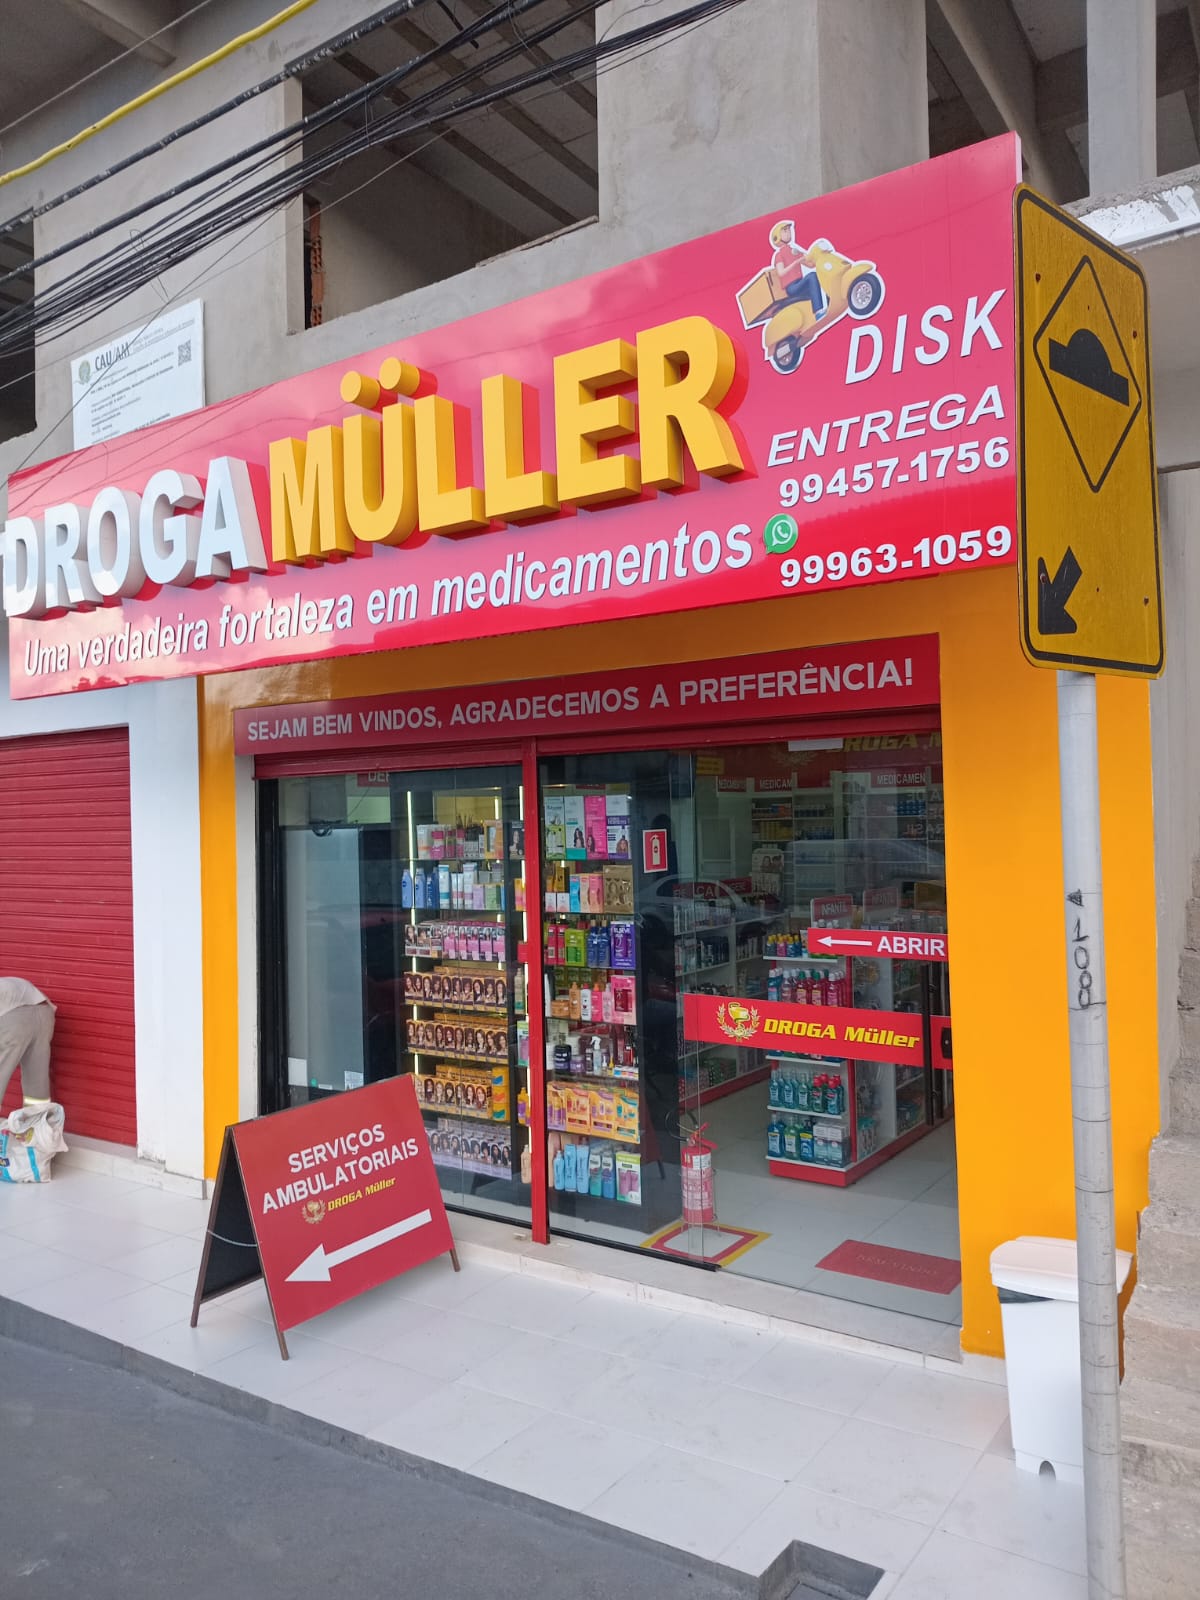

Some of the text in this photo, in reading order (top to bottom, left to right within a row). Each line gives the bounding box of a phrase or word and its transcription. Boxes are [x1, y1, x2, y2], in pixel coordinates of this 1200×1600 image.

[845, 289, 1007, 385] DISK
[767, 385, 1006, 467] ENTREGA
[3, 316, 744, 617] DROGA MÜLLER
[779, 436, 1010, 508] 99457-1756
[780, 525, 1012, 587] 99963-1059
[24, 521, 753, 677] Uma verdadeira fortaleza em medicamentos
[247, 657, 913, 741] SEJAM BEM VINDOS, AGRADECEMOS A PREFERÊNCIA!
[876, 934, 946, 957] ABRIR
[763, 1018, 920, 1048] DROGA Müller
[263, 1138, 419, 1214] AMBULATORIAIS
[288, 1123, 385, 1173] SERVIÇOS
[327, 1177, 397, 1212] DROGA Müller
